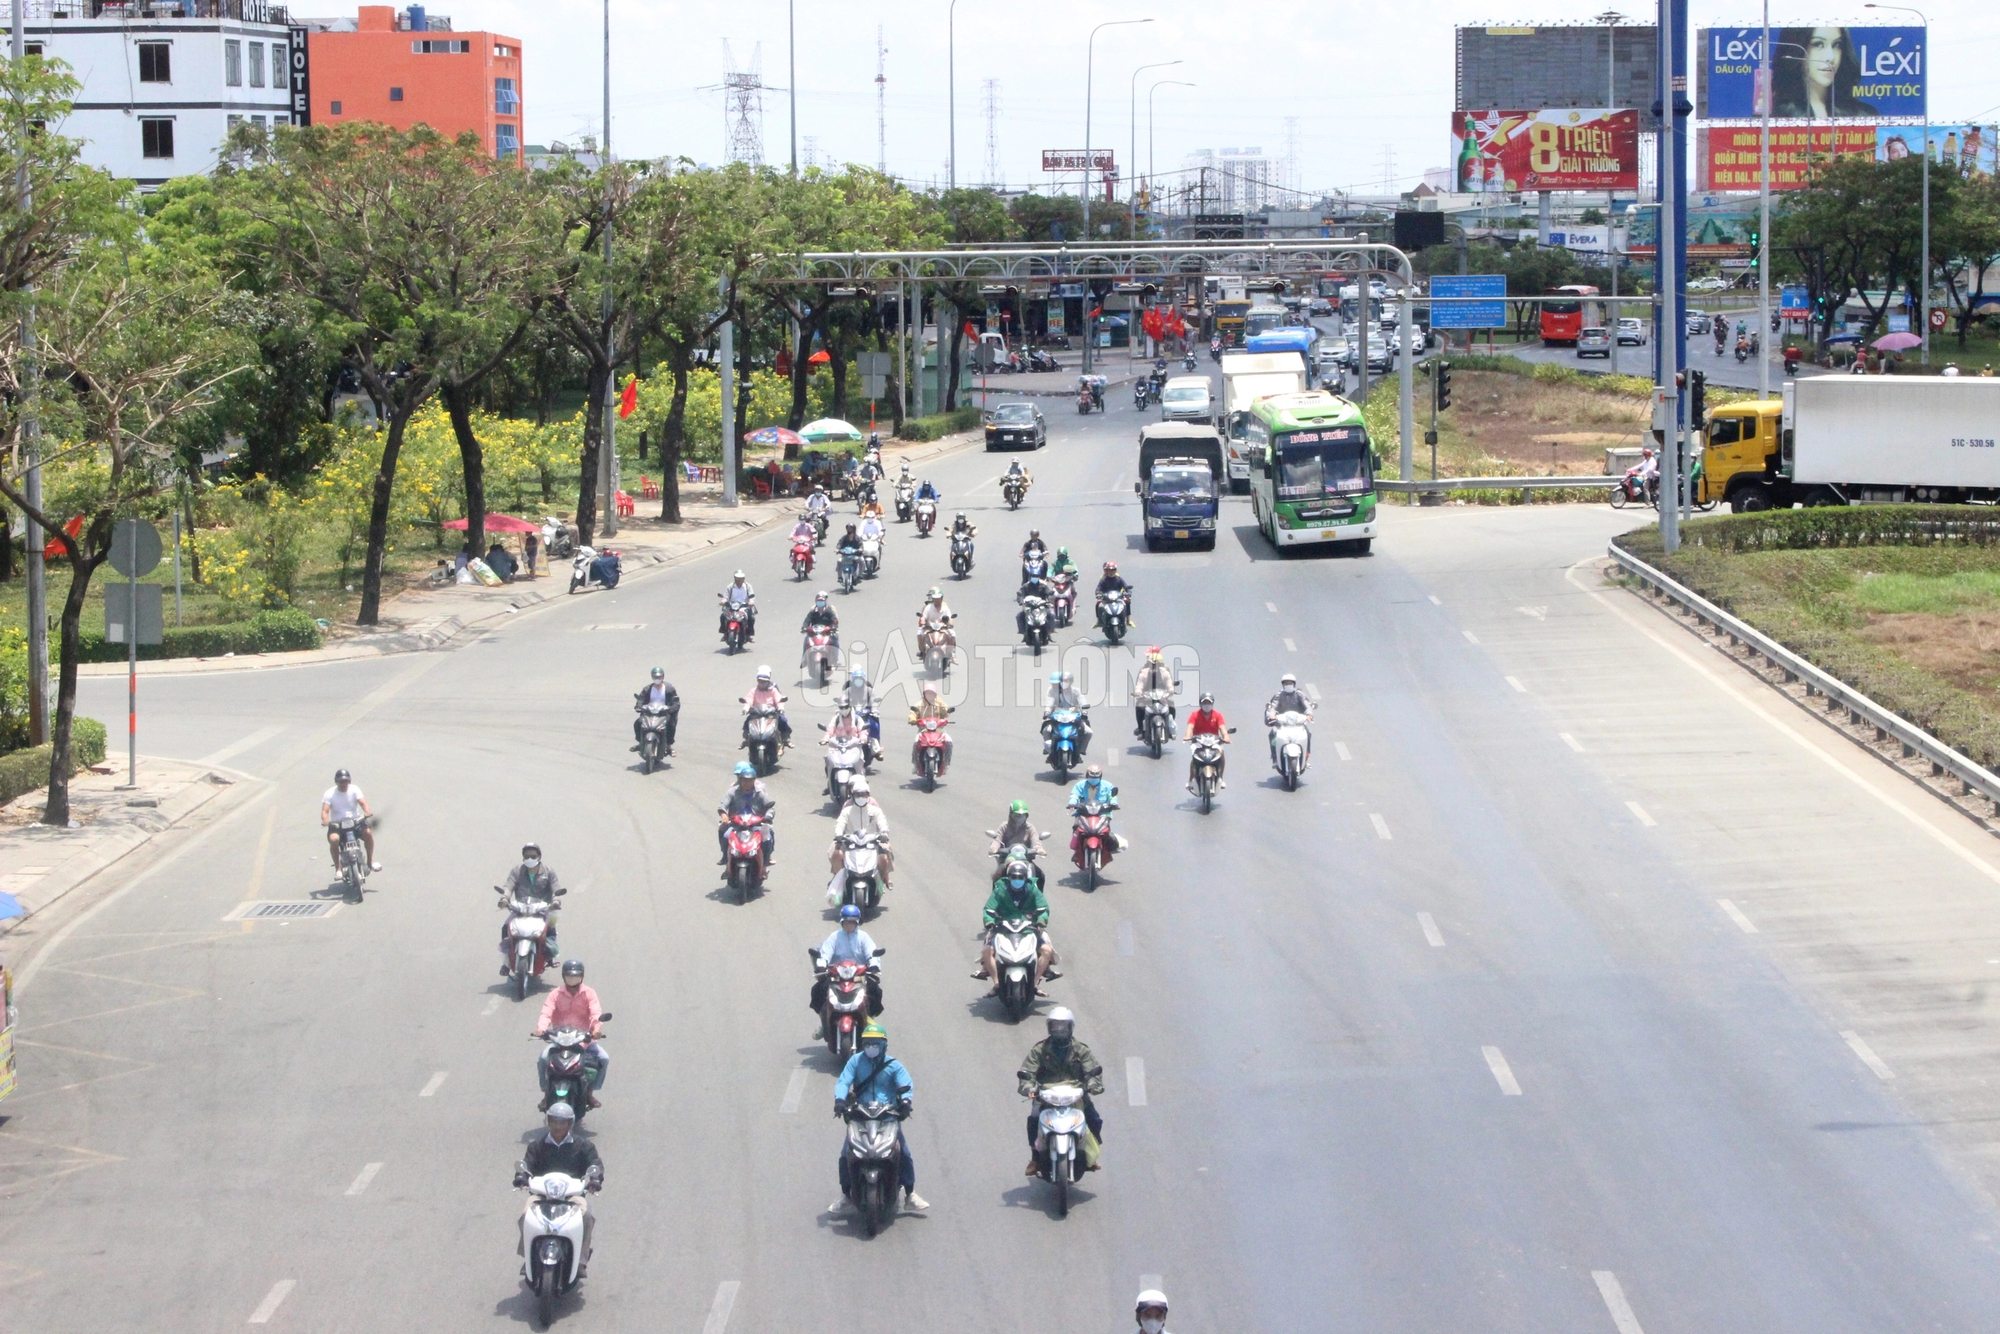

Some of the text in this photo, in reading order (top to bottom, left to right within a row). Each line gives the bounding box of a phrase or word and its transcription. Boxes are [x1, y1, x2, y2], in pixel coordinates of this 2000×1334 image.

[242, 0, 271, 22] HOTEL
[1735, 62, 1752, 76] GỘI
[1852, 82, 1921, 100] MƯỢT TÓC
[1530, 121, 1560, 173] 8
[1560, 125, 1613, 158] TRIỆU
[1733, 132, 1757, 146] MỪNG
[1779, 132, 1795, 145] MỚI
[1560, 153, 1582, 173] GIẢI
[1715, 150, 1736, 166] QUẬN
